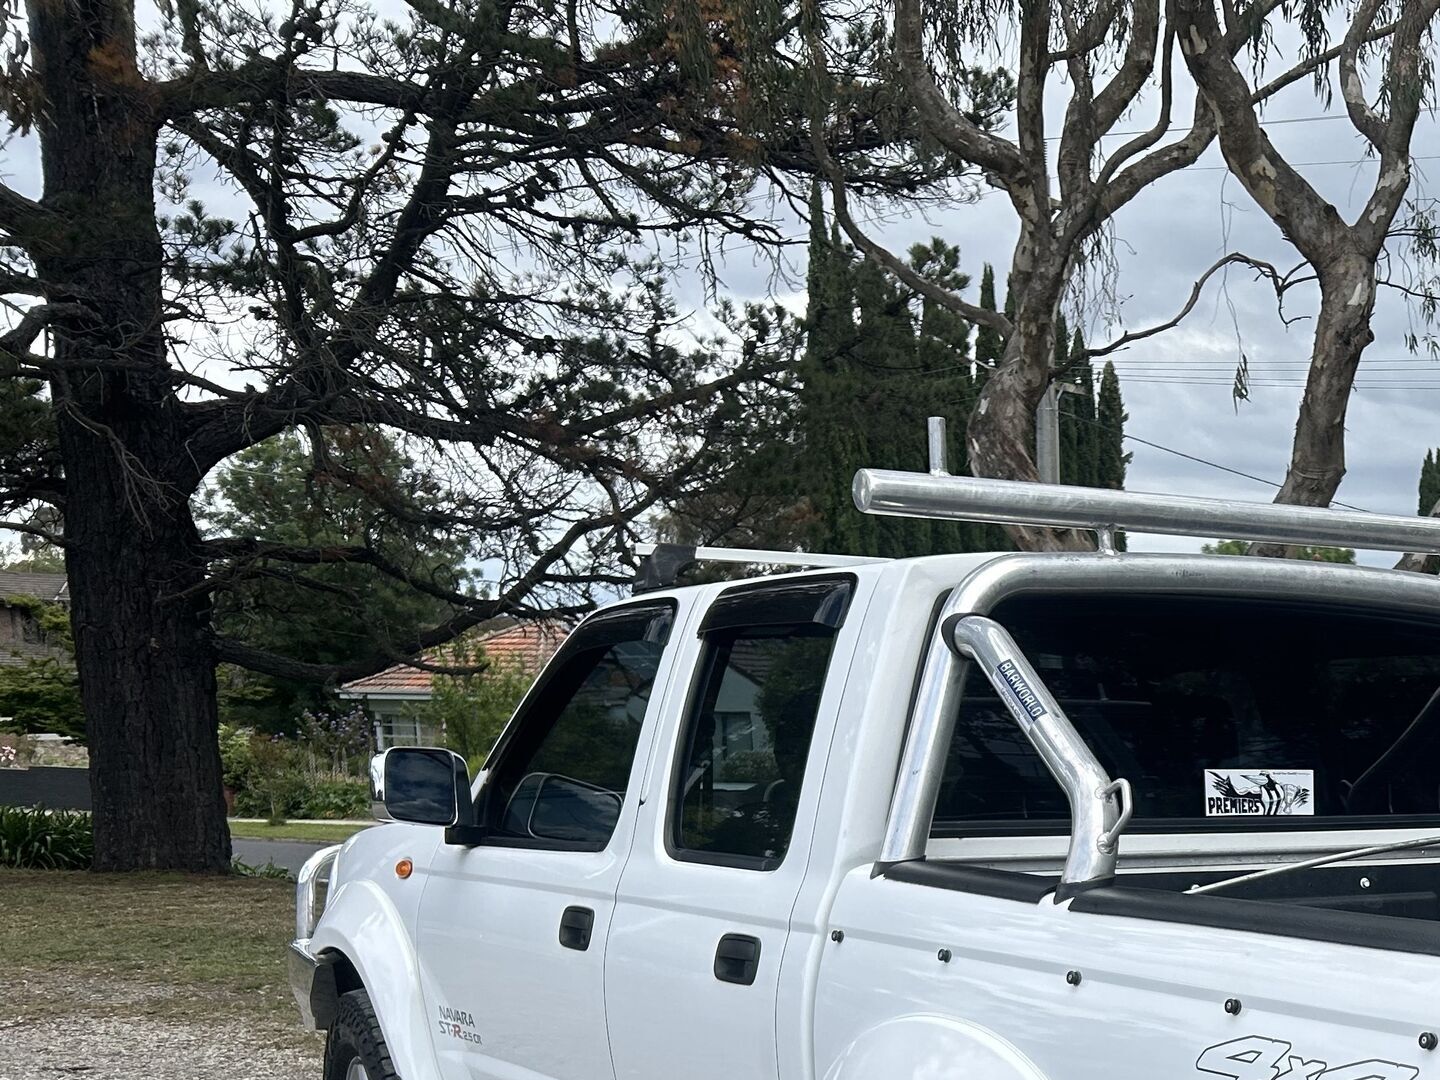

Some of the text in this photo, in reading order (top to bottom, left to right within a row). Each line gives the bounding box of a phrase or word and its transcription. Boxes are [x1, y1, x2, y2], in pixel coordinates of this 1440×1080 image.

[1000, 661, 1044, 719] BARWORLD
[1207, 796, 1260, 814] PREMIERS
[438, 1004, 475, 1028] NAVARA
